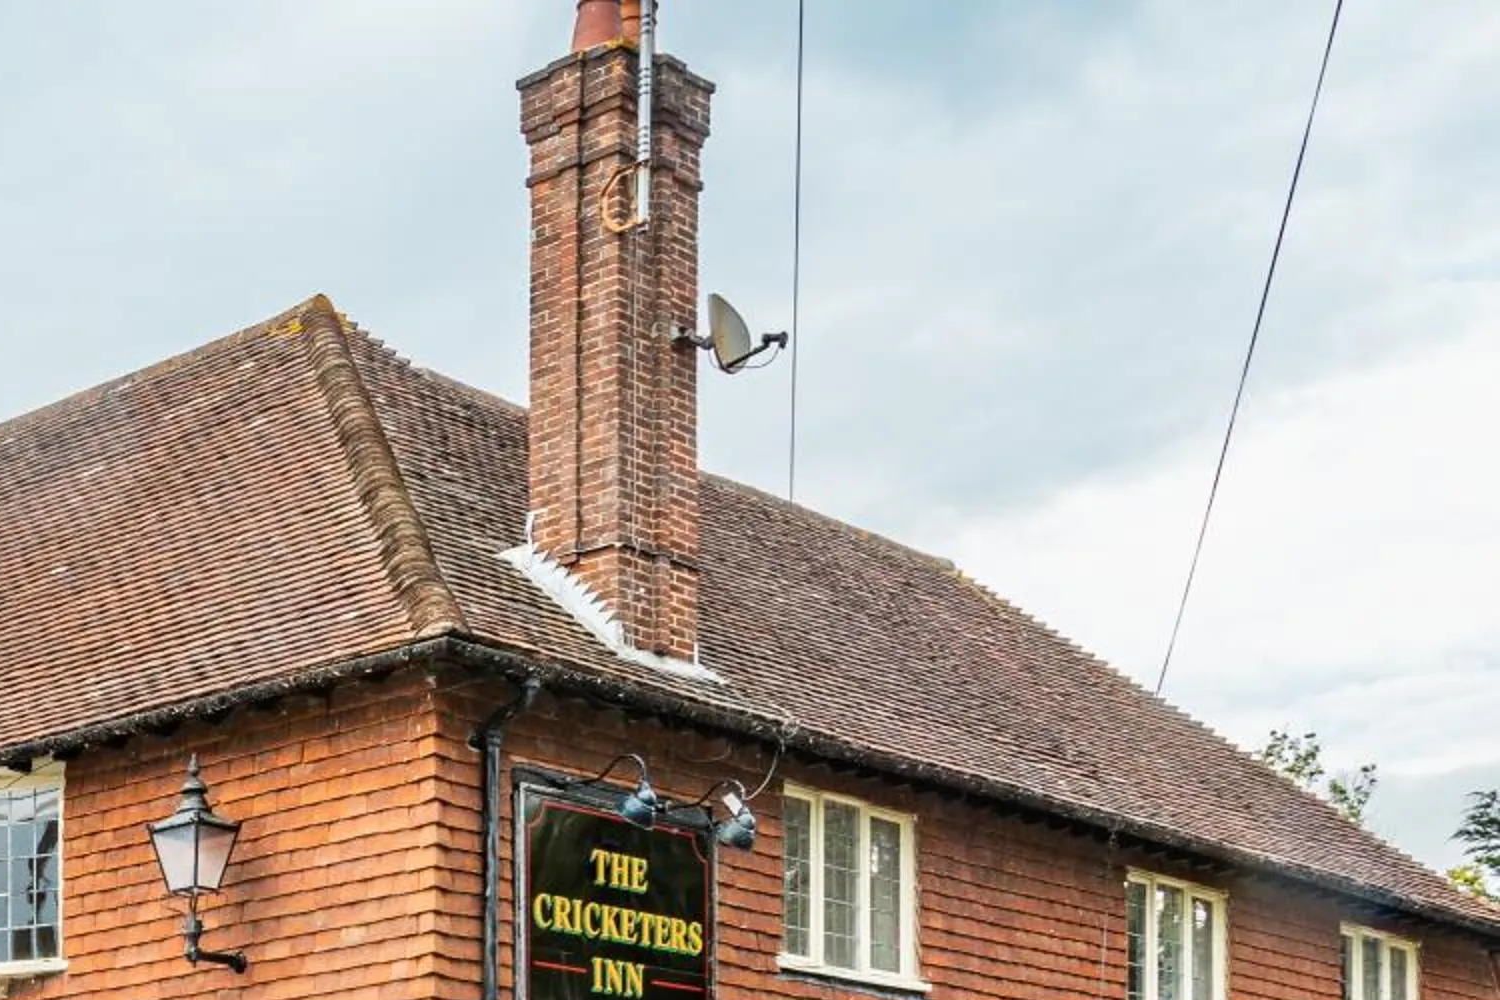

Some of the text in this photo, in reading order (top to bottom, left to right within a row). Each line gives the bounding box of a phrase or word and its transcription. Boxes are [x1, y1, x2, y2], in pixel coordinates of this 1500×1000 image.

[590, 849, 649, 893] THE
[533, 893, 704, 957] CRICKETERS
[591, 957, 645, 999] INN
